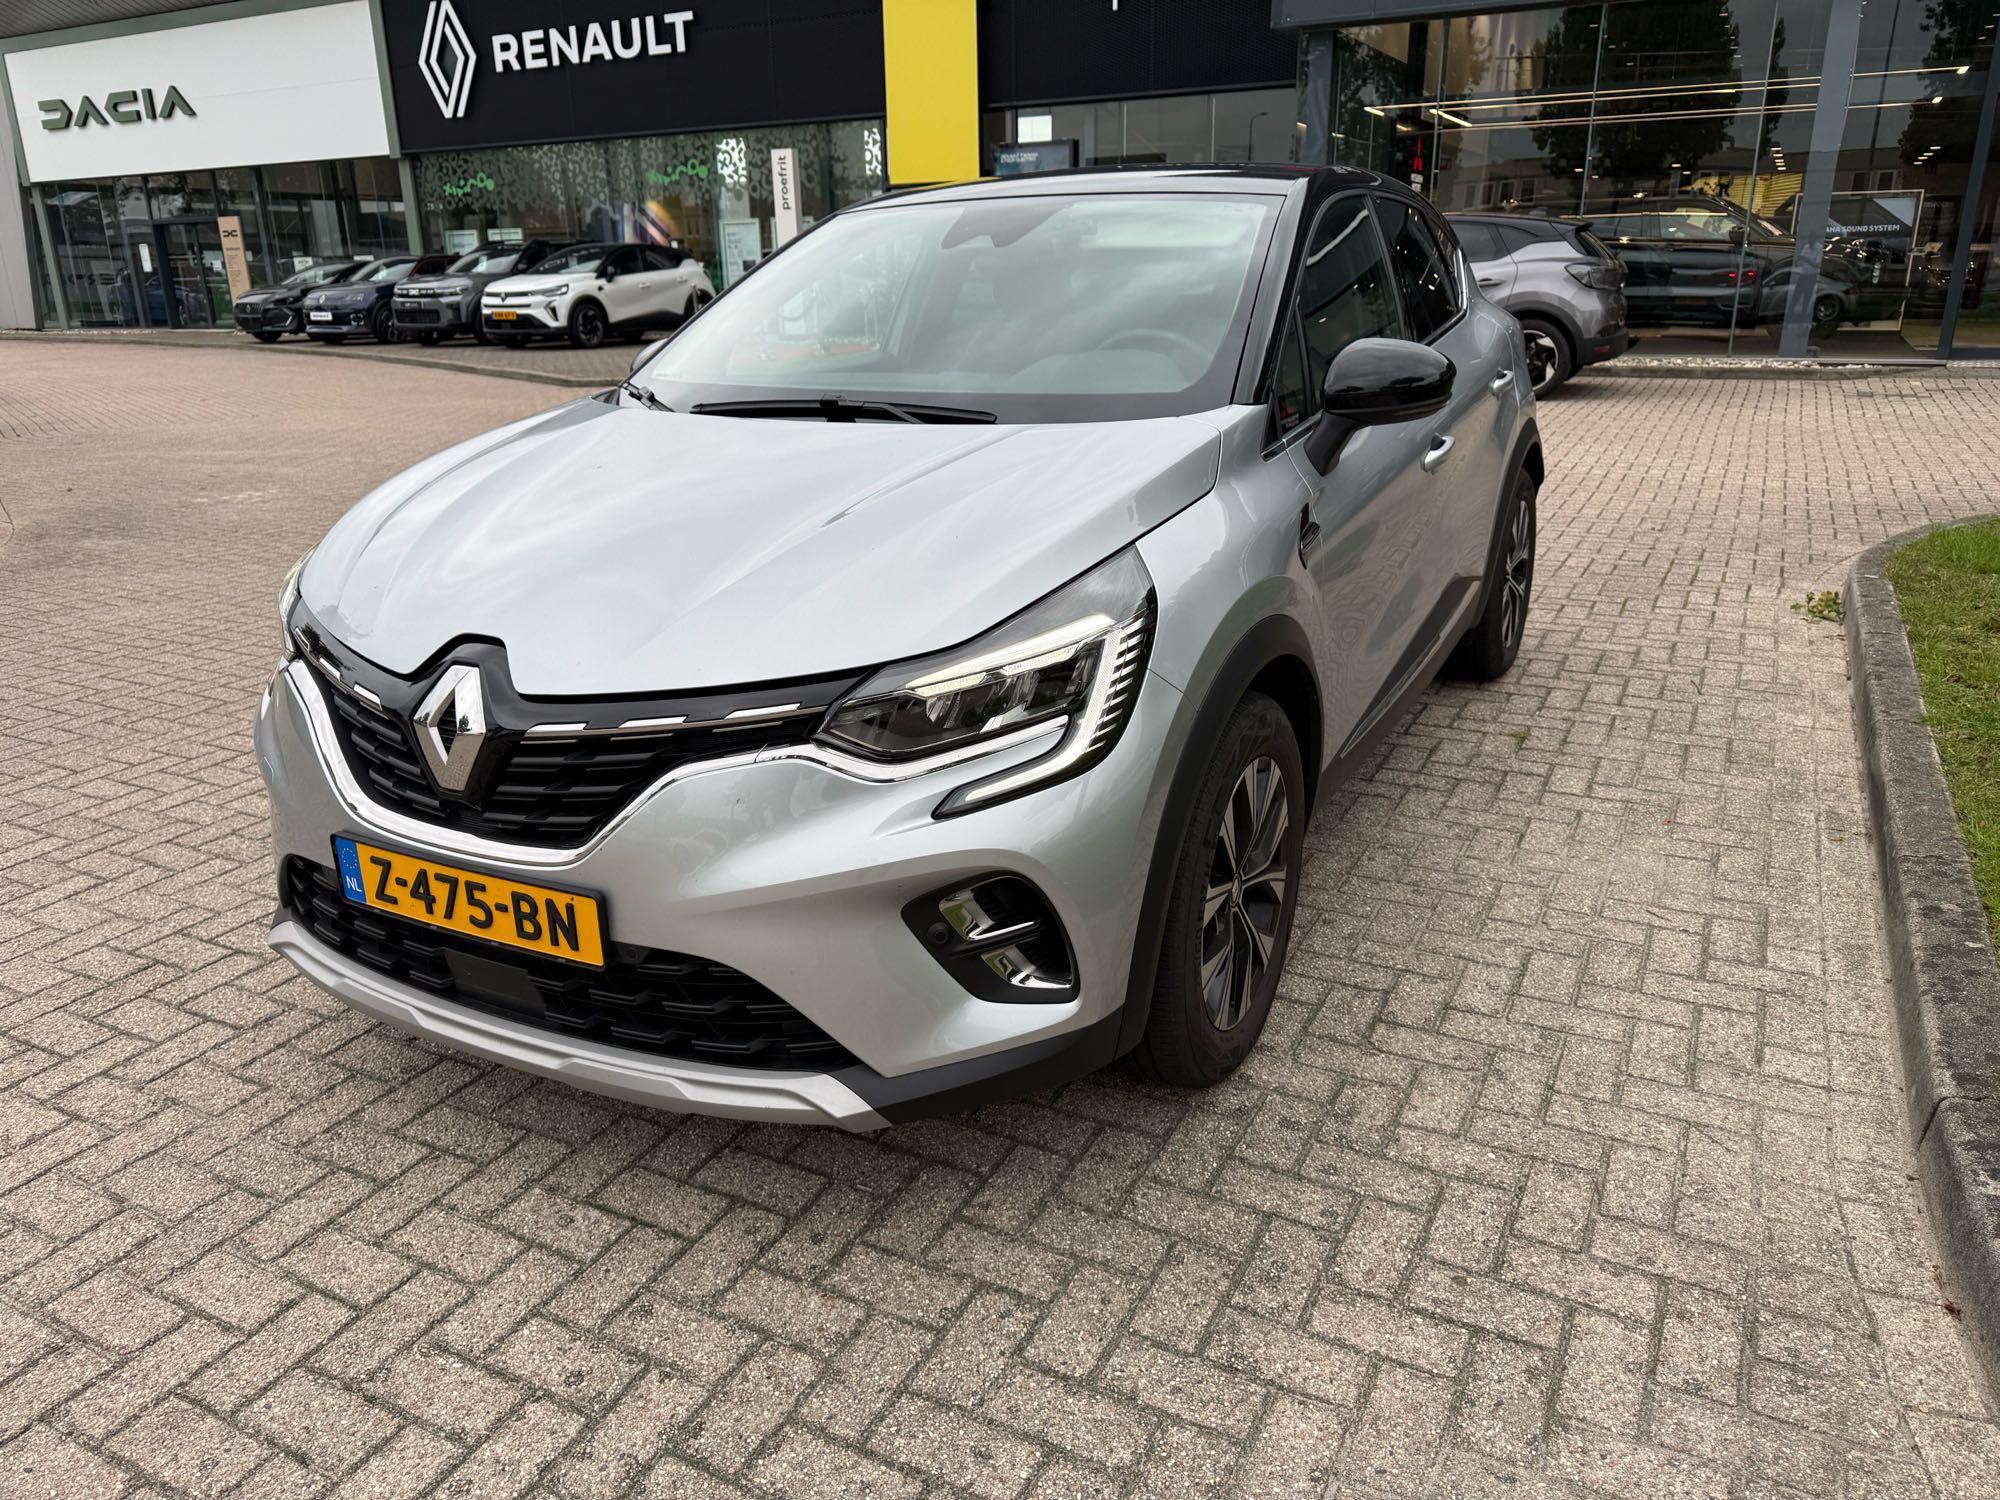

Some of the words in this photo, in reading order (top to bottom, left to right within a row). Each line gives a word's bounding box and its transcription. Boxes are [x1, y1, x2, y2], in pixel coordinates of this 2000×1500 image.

[491, 10, 694, 73] RENAULT
[37, 84, 196, 131] DACIA
[777, 155, 792, 210] proefrit
[1840, 225, 1868, 233] SOUND
[1868, 224, 1900, 232] SYSTEM
[346, 874, 363, 893] NL
[370, 855, 580, 951] Z-475-BN
